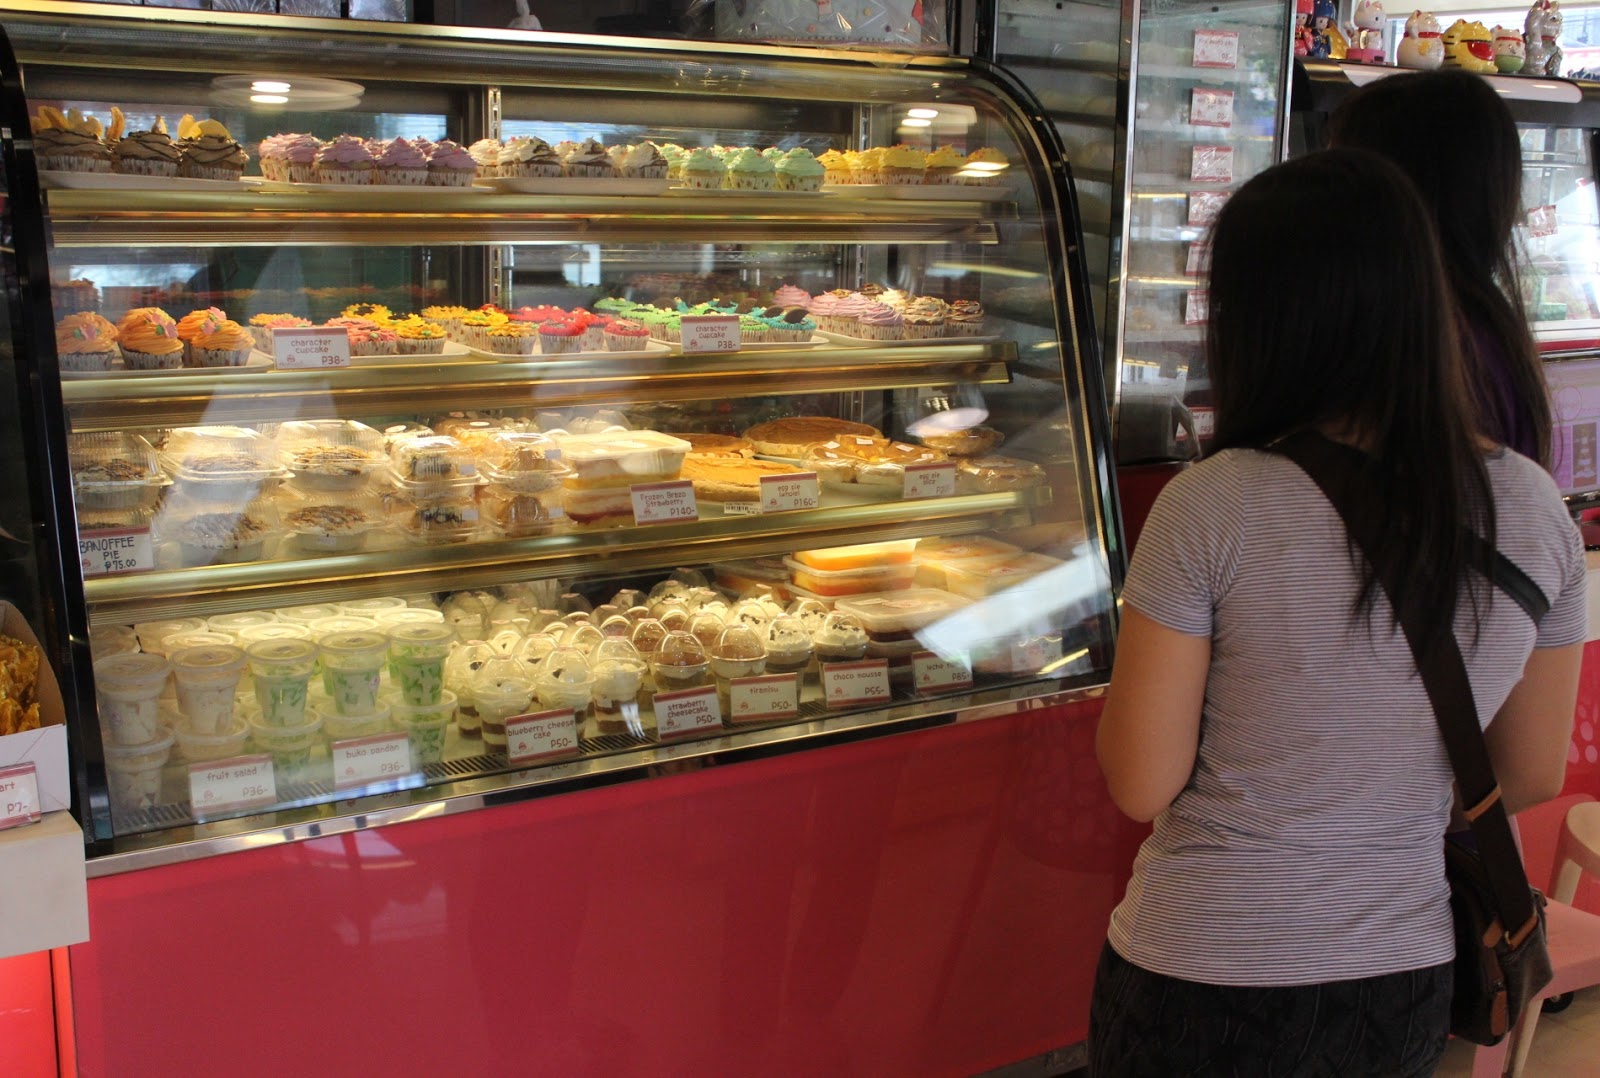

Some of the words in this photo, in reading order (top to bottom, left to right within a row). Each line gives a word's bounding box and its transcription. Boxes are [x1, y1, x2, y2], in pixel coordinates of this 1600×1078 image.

[290, 339, 332, 347] character
[718, 340, 736, 349] P38-
[295, 346, 329, 354] cupcake
[321, 355, 345, 365] P38-
[667, 491, 687, 499] Brazo
[645, 499, 685, 508] Strawberry
[793, 497, 817, 507] P160-
[670, 506, 696, 517] P140-
[79, 536, 135, 553] BANOFFEE
[103, 551, 119, 560] PIE
[833, 673, 855, 681] choco
[750, 685, 778, 693] tiramisu
[667, 699, 706, 711] strawberry
[771, 700, 792, 710] P50-
[667, 706, 709, 718] cheesecake
[696, 714, 716, 726] P50-
[507, 724, 544, 737] blueberry
[547, 719, 575, 730] cheese
[533, 731, 551, 740] cake
[550, 737, 572, 748] P50-
[346, 749, 367, 759] buko
[370, 743, 400, 755] pandan
[207, 772, 230, 782] fruit
[234, 766, 257, 778] salad
[7, 801, 28, 814] P7-
